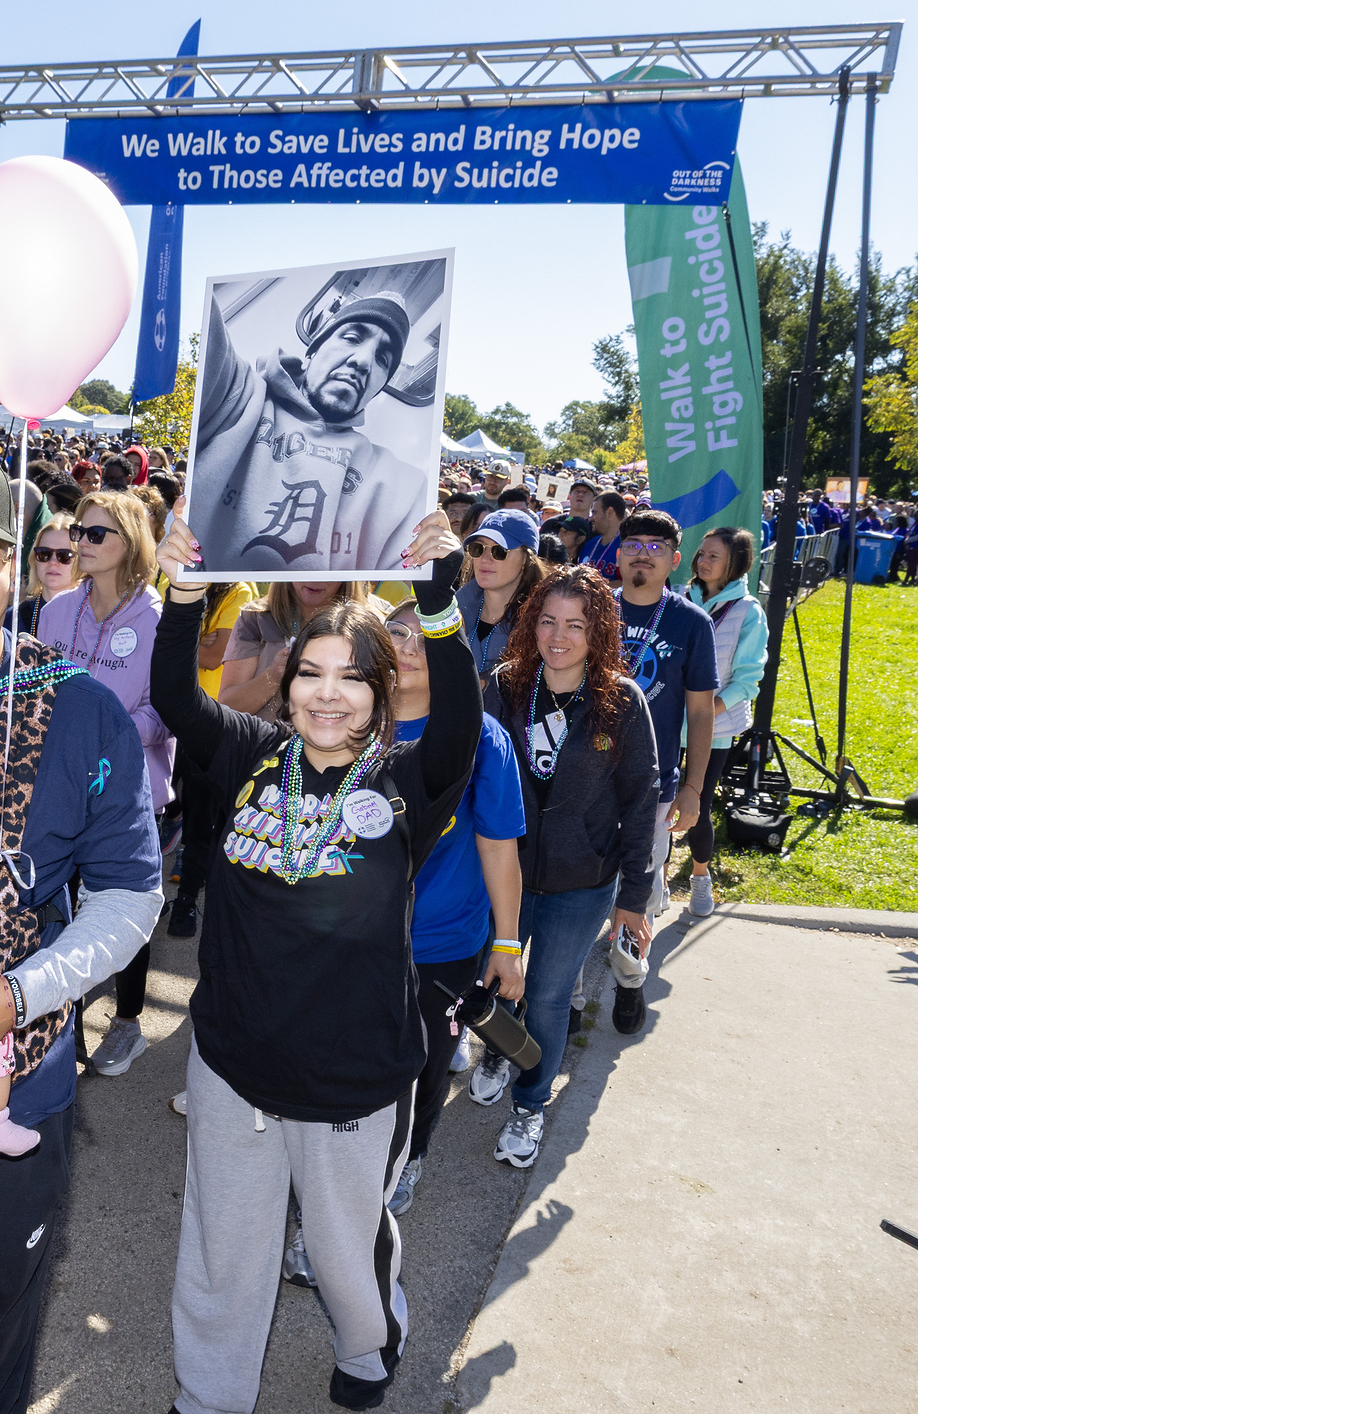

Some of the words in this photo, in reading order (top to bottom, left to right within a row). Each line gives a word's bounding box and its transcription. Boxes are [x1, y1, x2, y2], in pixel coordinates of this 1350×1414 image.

[122, 133, 159, 157] We
[168, 129, 228, 157] Walk
[234, 132, 261, 154] to
[267, 129, 329, 154] Save
[337, 127, 403, 153] Lives
[411, 124, 466, 152] and
[474, 123, 551, 157] Bring
[559, 123, 640, 155] Hope
[177, 168, 202, 191] to
[209, 163, 283, 189] Those
[290, 161, 404, 188] Affected
[412, 160, 447, 194] by
[454, 160, 559, 188] Suicide
[671, 178, 722, 186] DARKNESS
[672, 169, 691, 178] OUT
[692, 169, 704, 178] OF
[705, 170, 723, 178] THE
[685, 204, 731, 343] Suicide
[660, 316, 686, 358] to
[659, 362, 697, 463] Walk
[704, 350, 744, 452] Fight
[356, 808, 382, 824] DAD
[10, 979, 23, 1012] YOURSELF
[332, 1121, 359, 1132] HIGH
